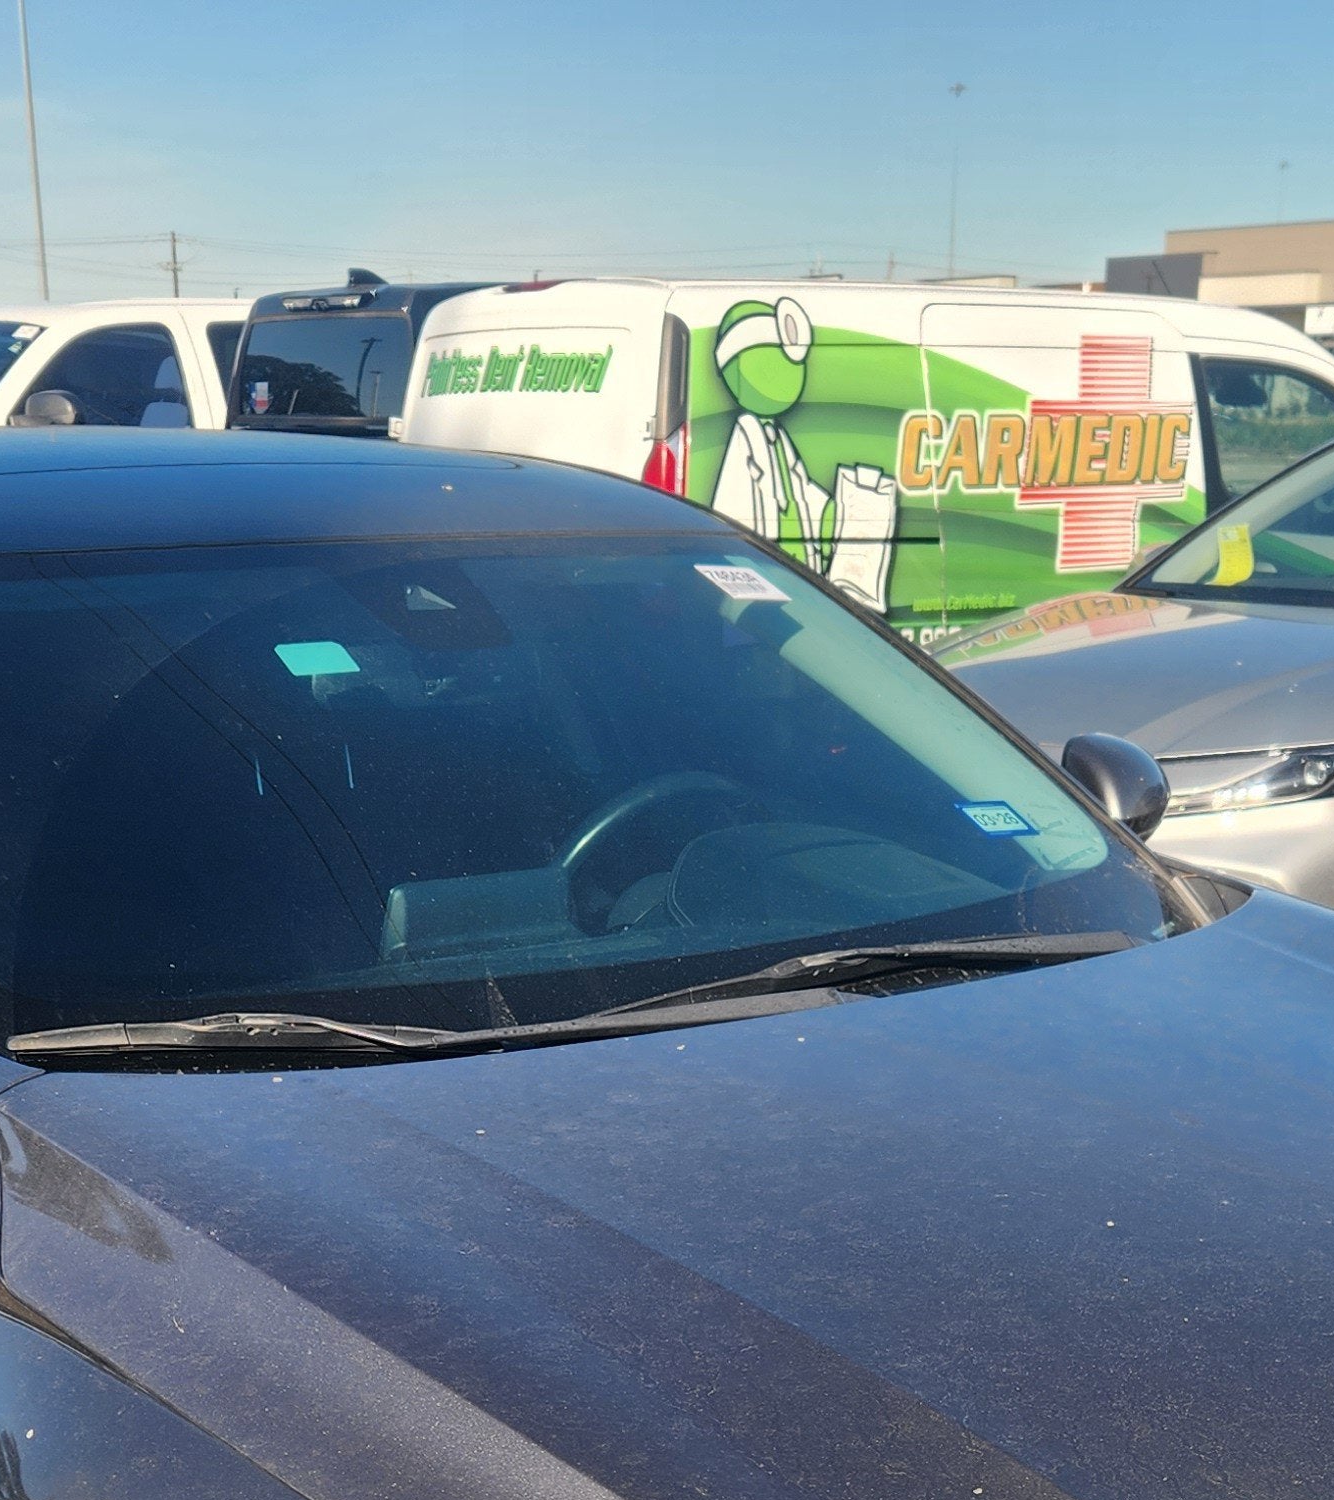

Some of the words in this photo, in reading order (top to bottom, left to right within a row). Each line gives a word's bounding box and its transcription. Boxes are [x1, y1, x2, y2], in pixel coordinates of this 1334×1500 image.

[479, 345, 525, 393] Dent
[519, 344, 613, 393] Removal
[898, 413, 1190, 488] CARMEDIC
